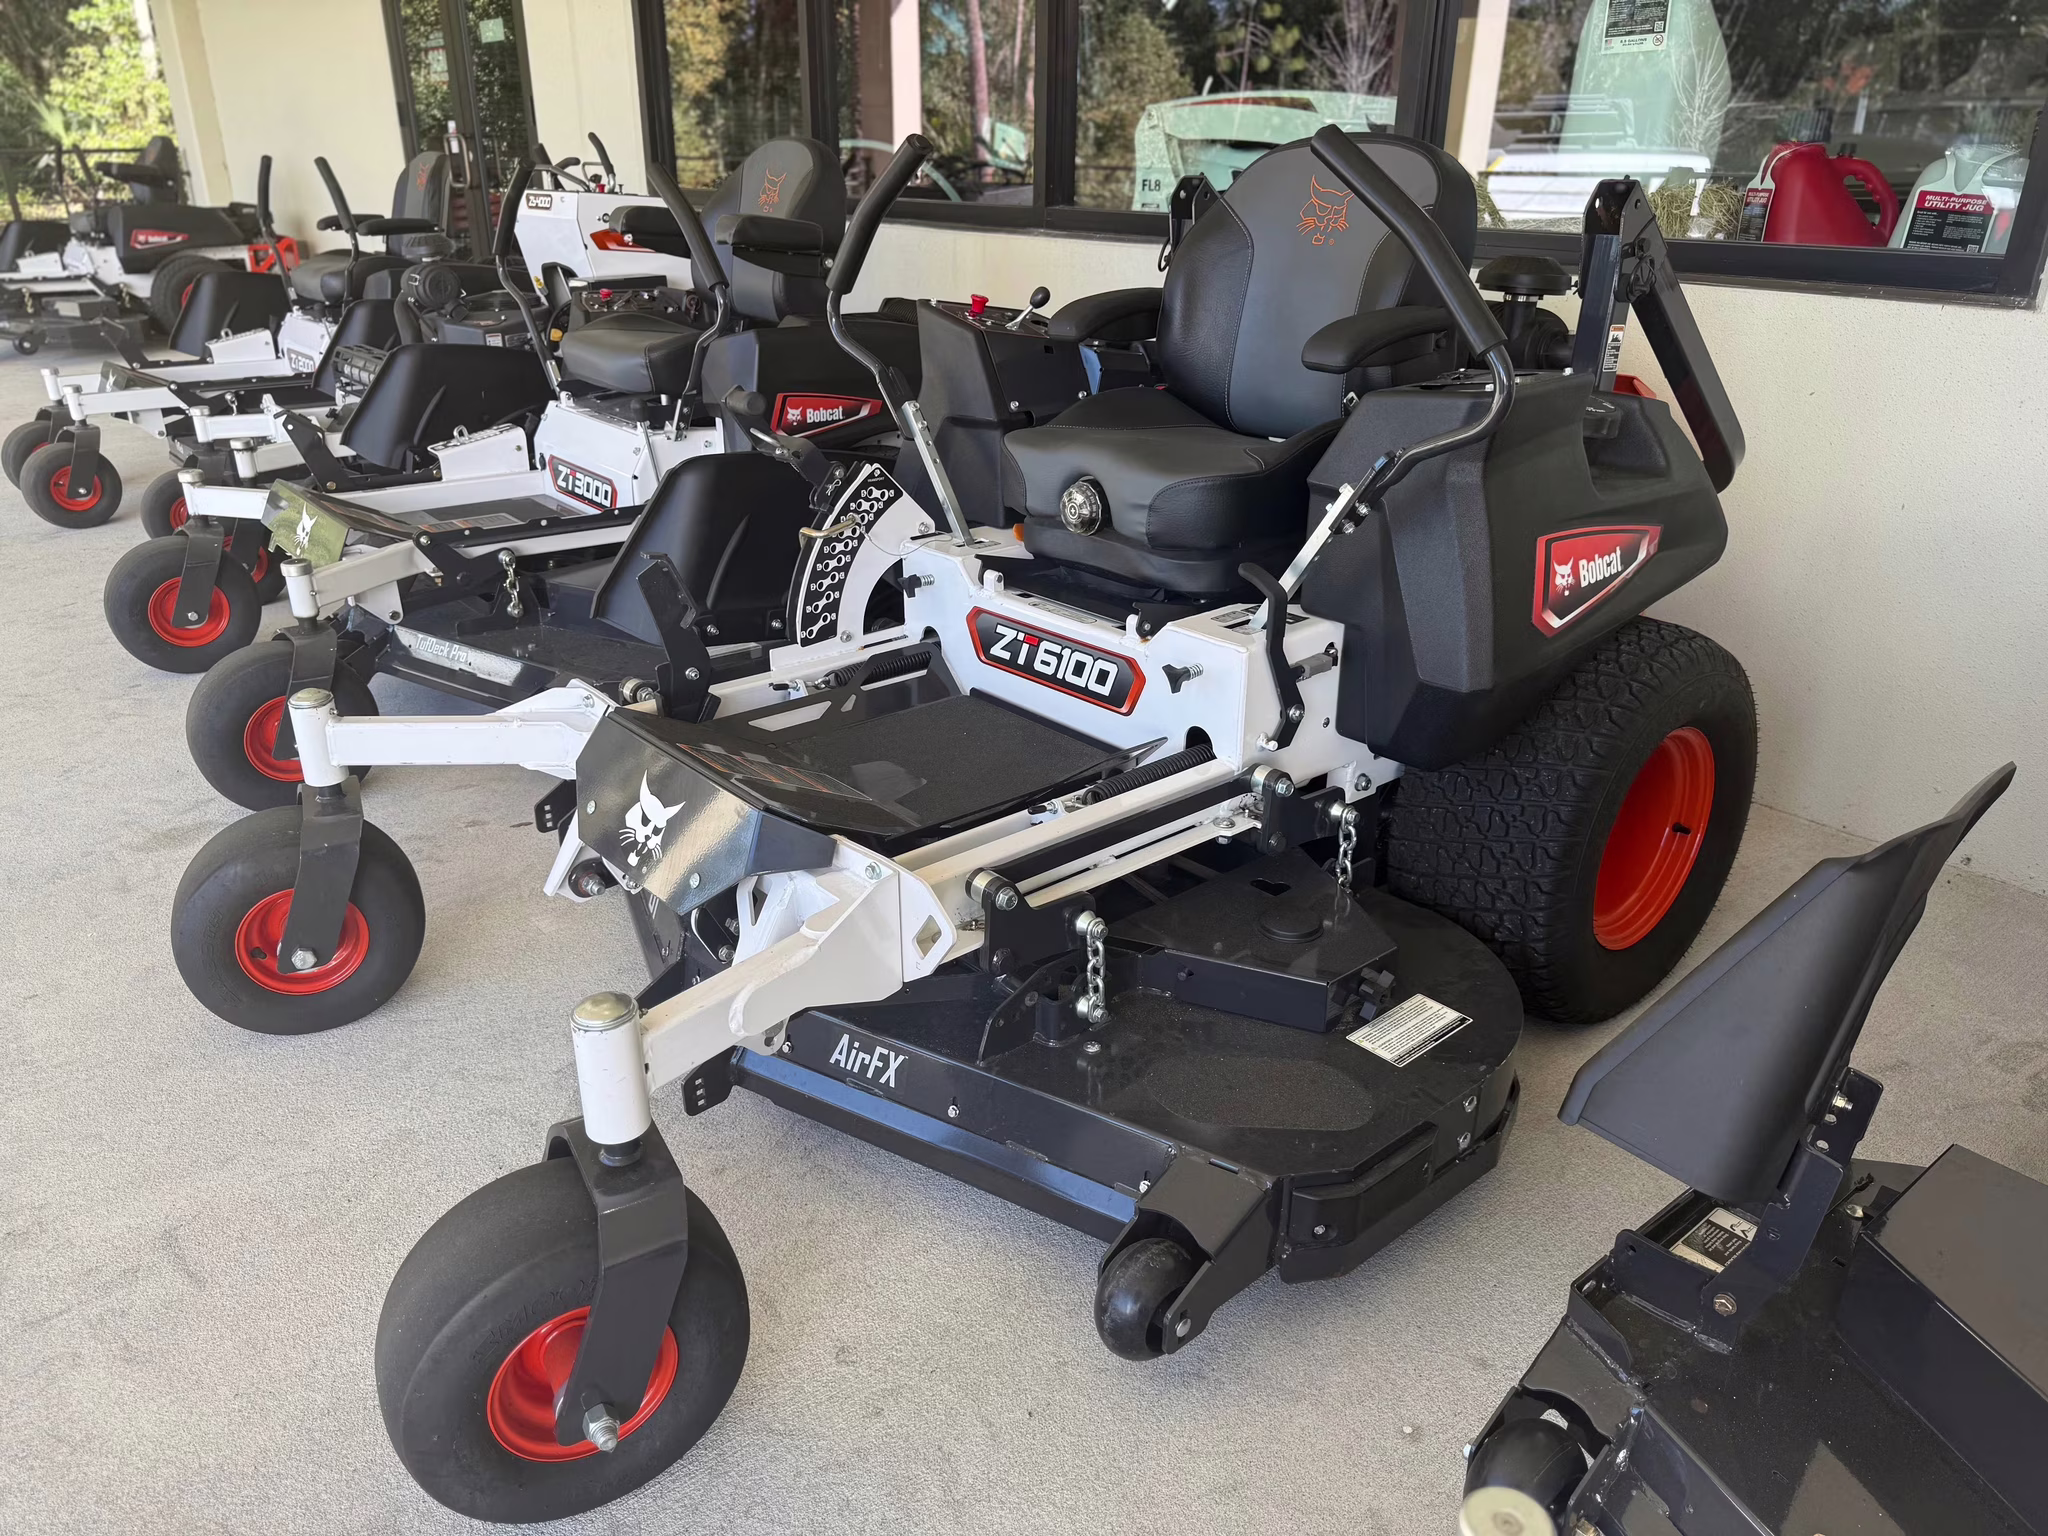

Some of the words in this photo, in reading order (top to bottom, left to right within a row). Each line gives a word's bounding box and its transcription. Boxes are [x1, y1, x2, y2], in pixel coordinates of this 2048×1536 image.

[1142, 179, 1161, 191] FL8
[1924, 200, 1962, 210] UTILITY
[1962, 203, 1984, 212] JUG
[1925, 195, 1988, 205] MULTI-PURPOSE
[806, 405, 843, 423] Bobcat
[557, 464, 612, 508] ZT3000
[1578, 545, 1622, 588] Bobcat
[416, 634, 450, 657] TufDeck
[450, 644, 467, 662] Pro
[989, 624, 1118, 697] ZT6100
[829, 1033, 905, 1088] AirFX
